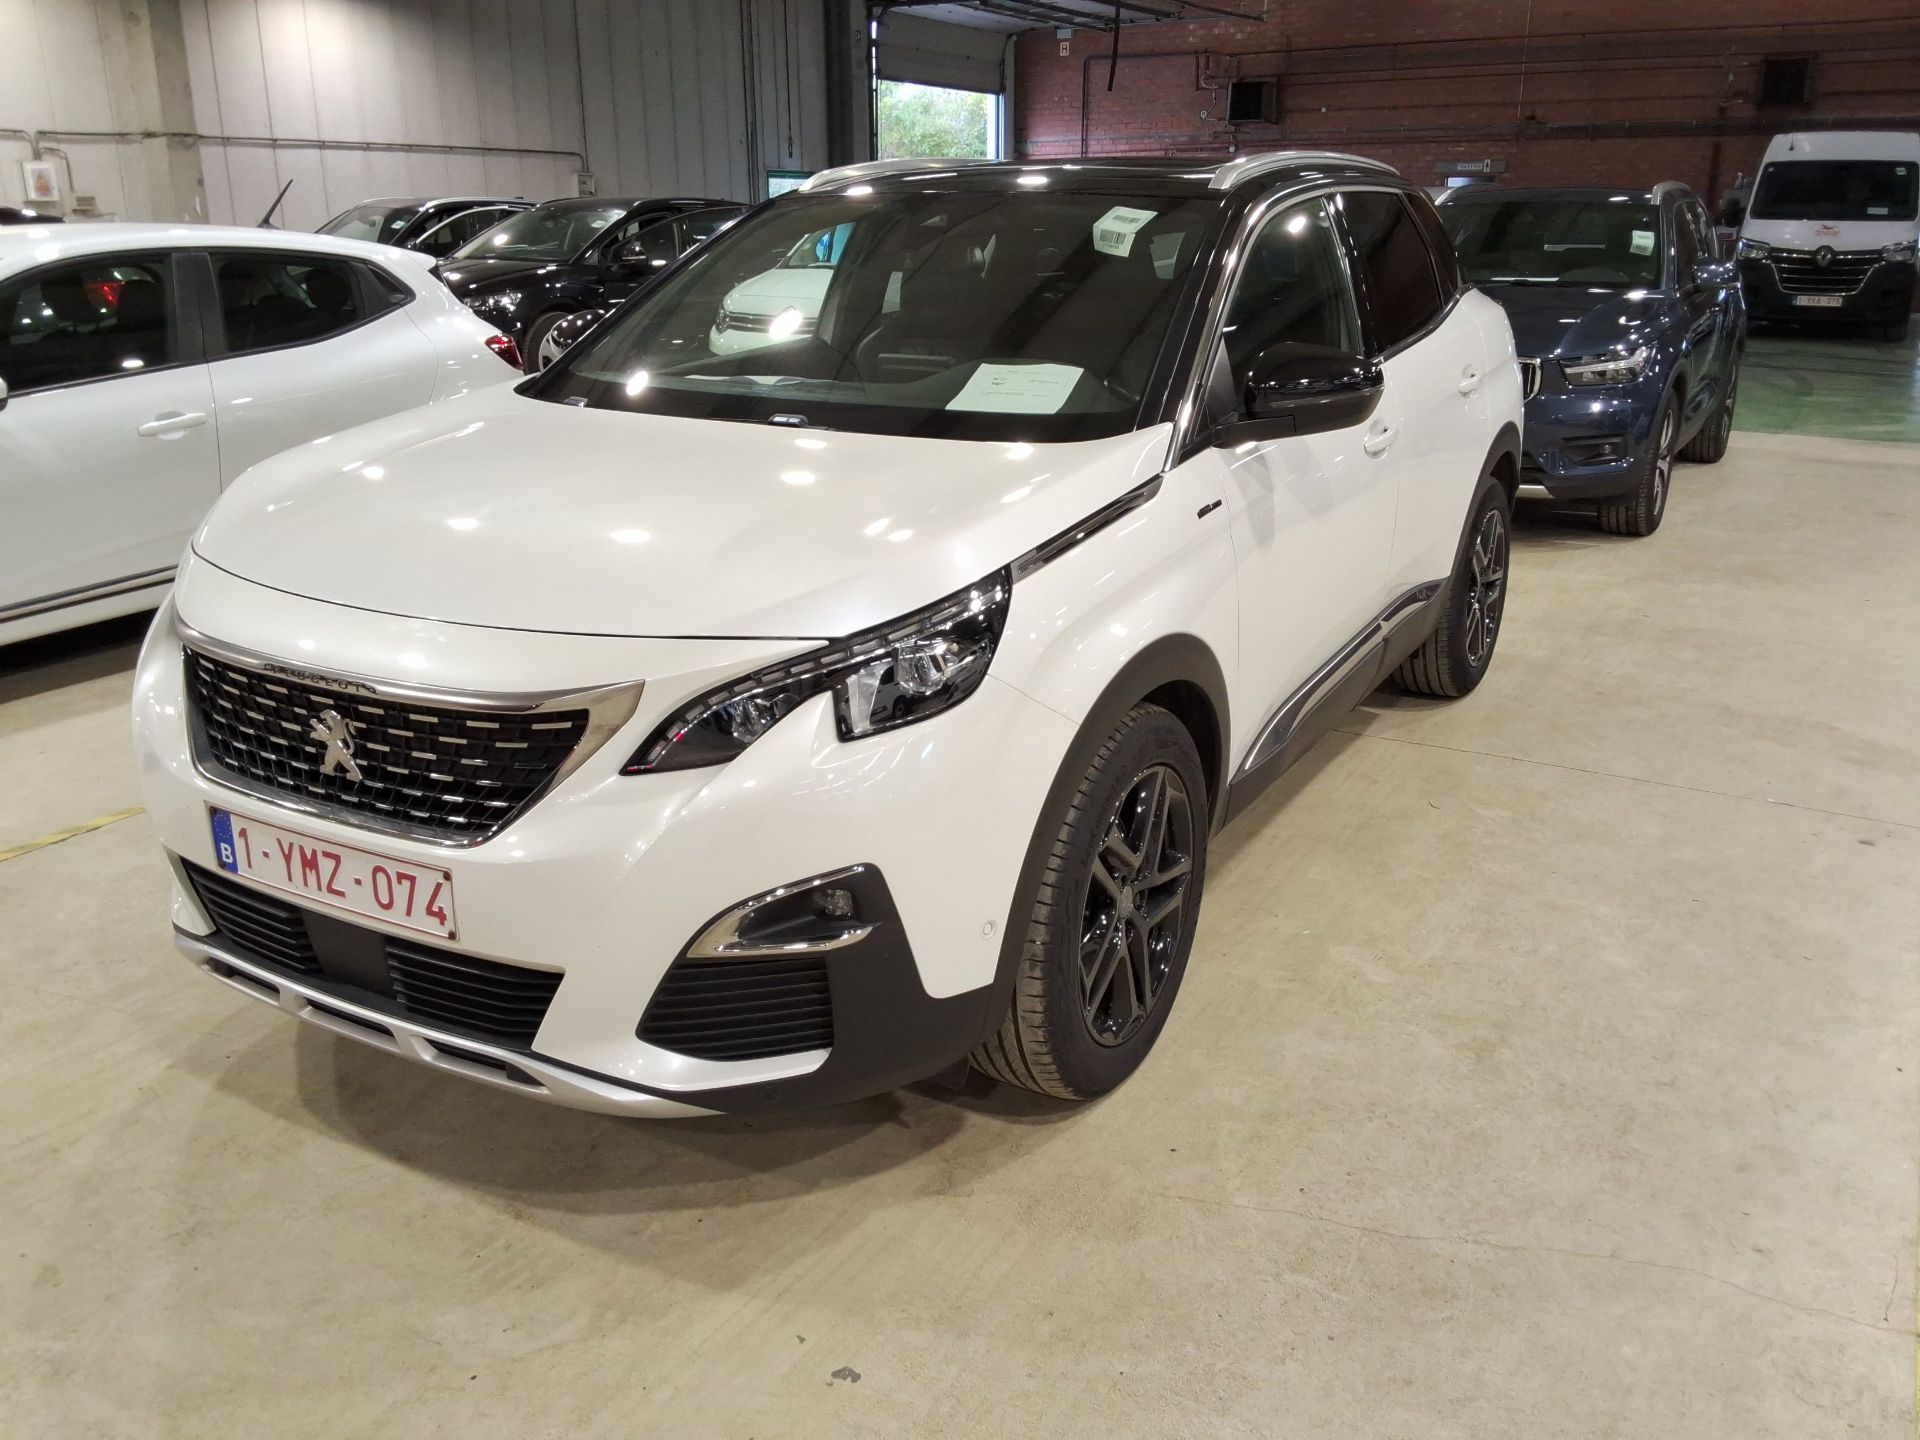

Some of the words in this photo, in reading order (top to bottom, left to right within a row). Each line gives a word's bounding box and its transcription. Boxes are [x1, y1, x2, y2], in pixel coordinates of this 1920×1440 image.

[265, 662, 361, 693] PEUGEOT
[220, 842, 233, 863] B
[238, 827, 447, 926] 1-YMZ-074
